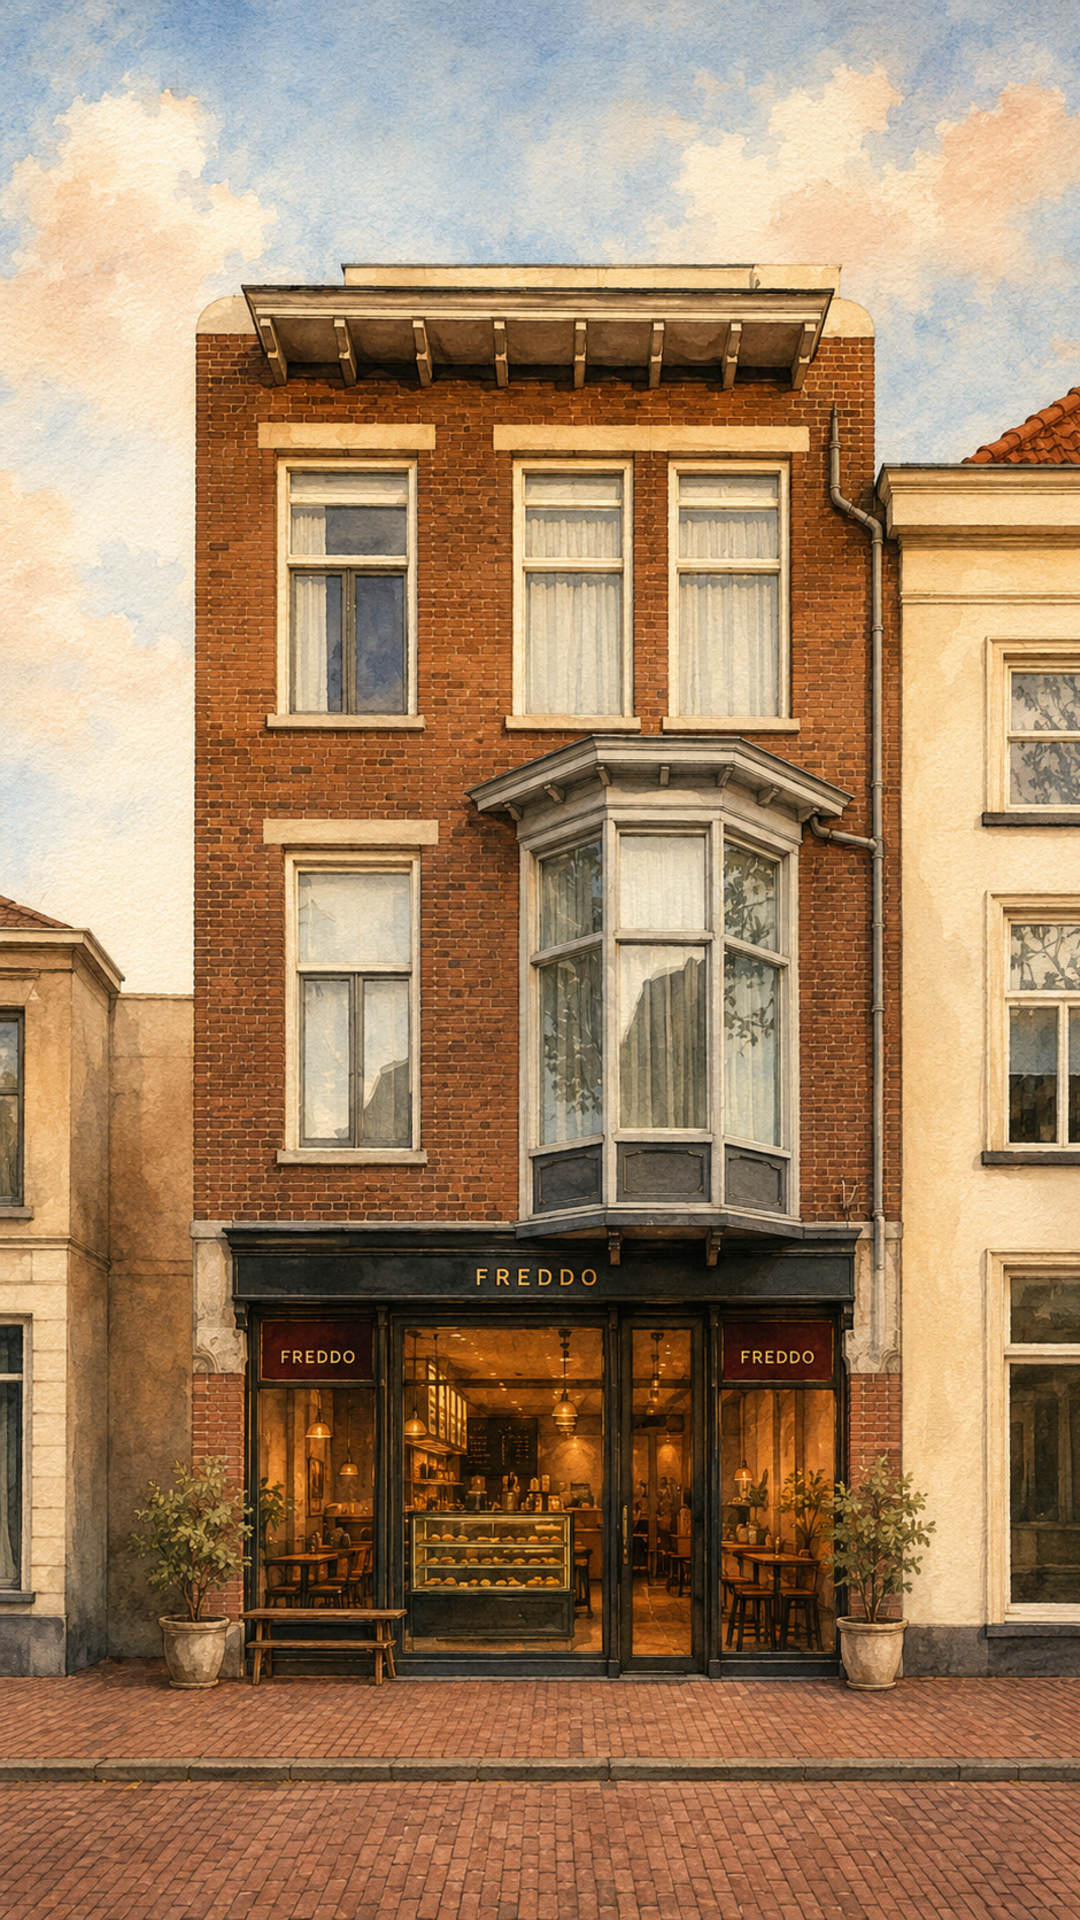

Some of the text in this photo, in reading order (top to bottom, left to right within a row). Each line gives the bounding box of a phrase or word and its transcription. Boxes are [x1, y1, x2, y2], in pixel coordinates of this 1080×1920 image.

[476, 1268, 597, 1286] FREDDO
[281, 1350, 355, 1364] FREDDO
[741, 1350, 815, 1364] FREDDO
